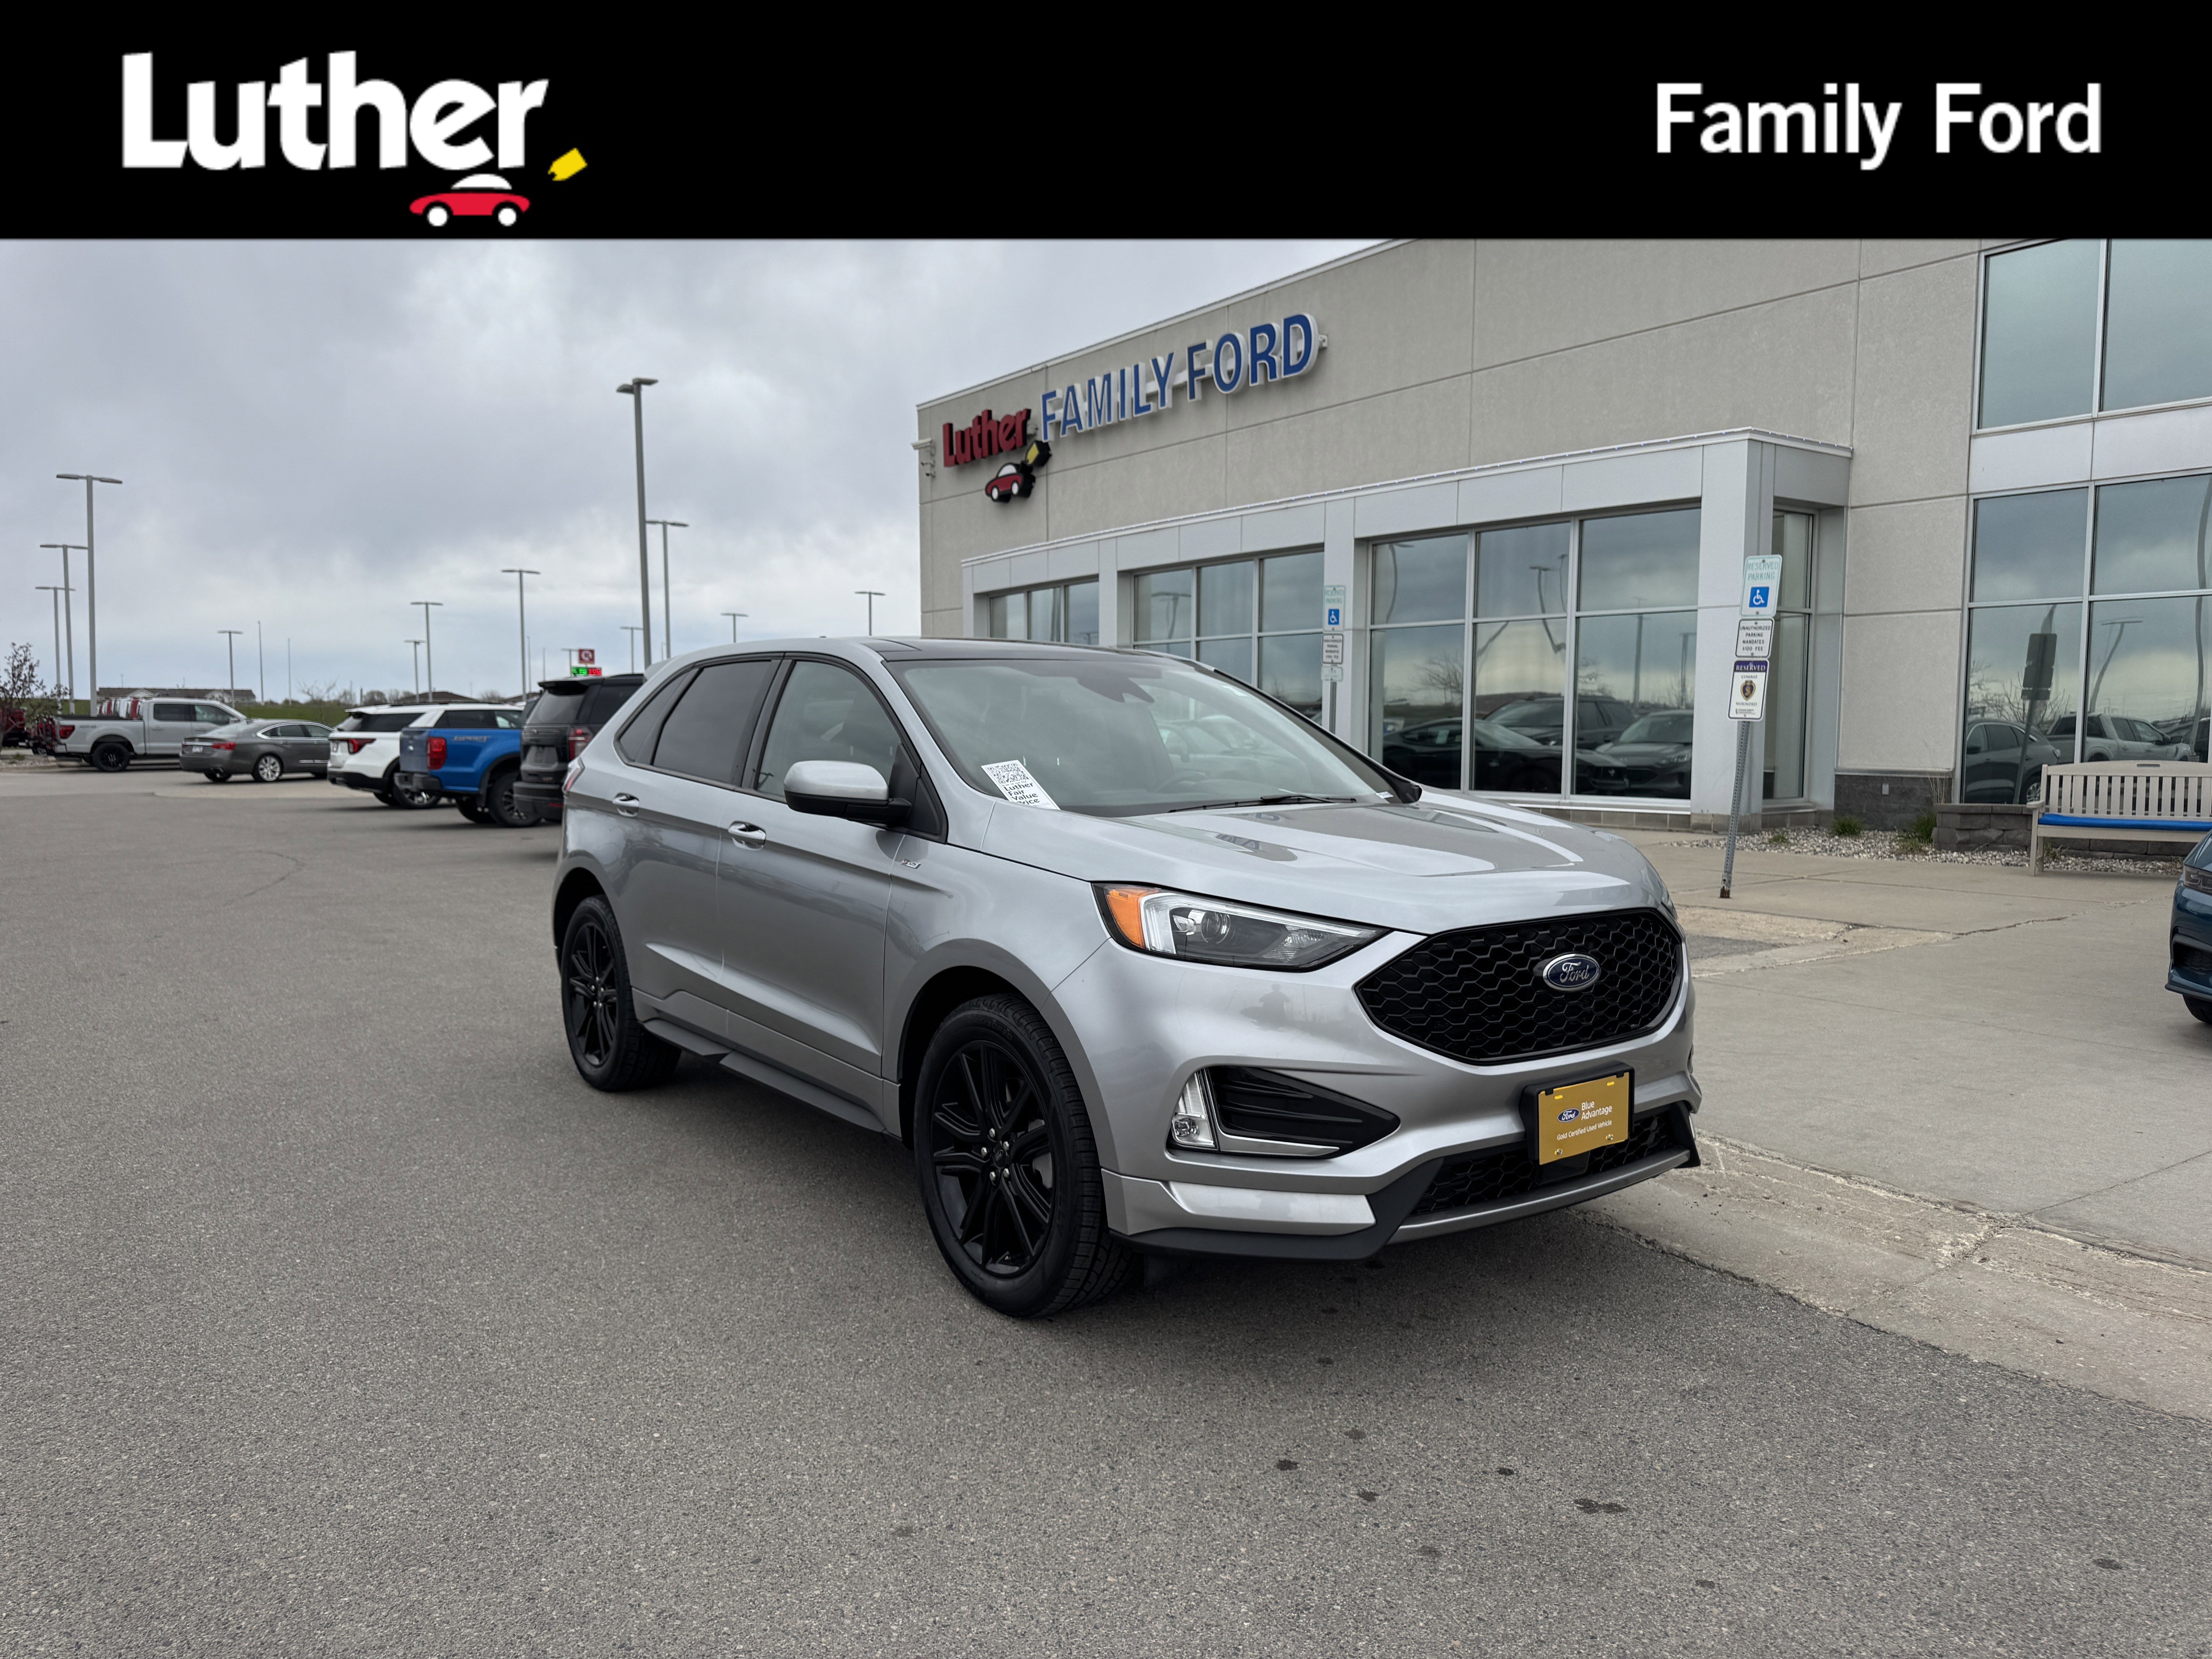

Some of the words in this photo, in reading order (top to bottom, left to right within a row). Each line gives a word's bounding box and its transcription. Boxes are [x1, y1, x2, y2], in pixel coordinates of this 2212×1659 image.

[1041, 352, 1175, 442] FAMILY
[1187, 313, 1318, 402] FORD
[943, 408, 1031, 467] Luther
[1747, 562, 1778, 571] RESERVED
[1748, 572, 1775, 581] PARKING
[1004, 782, 1033, 791] Luther
[1560, 962, 1589, 983] Ford
[1582, 1101, 1595, 1111] Blue
[1561, 1110, 1576, 1121] Ford
[1581, 1106, 1612, 1120] Advantage
[1557, 1132, 1567, 1140] Gold
[1568, 1127, 1586, 1137] Certified
[1586, 1123, 1597, 1132] Used
[1597, 1120, 1612, 1128] Vehicle
